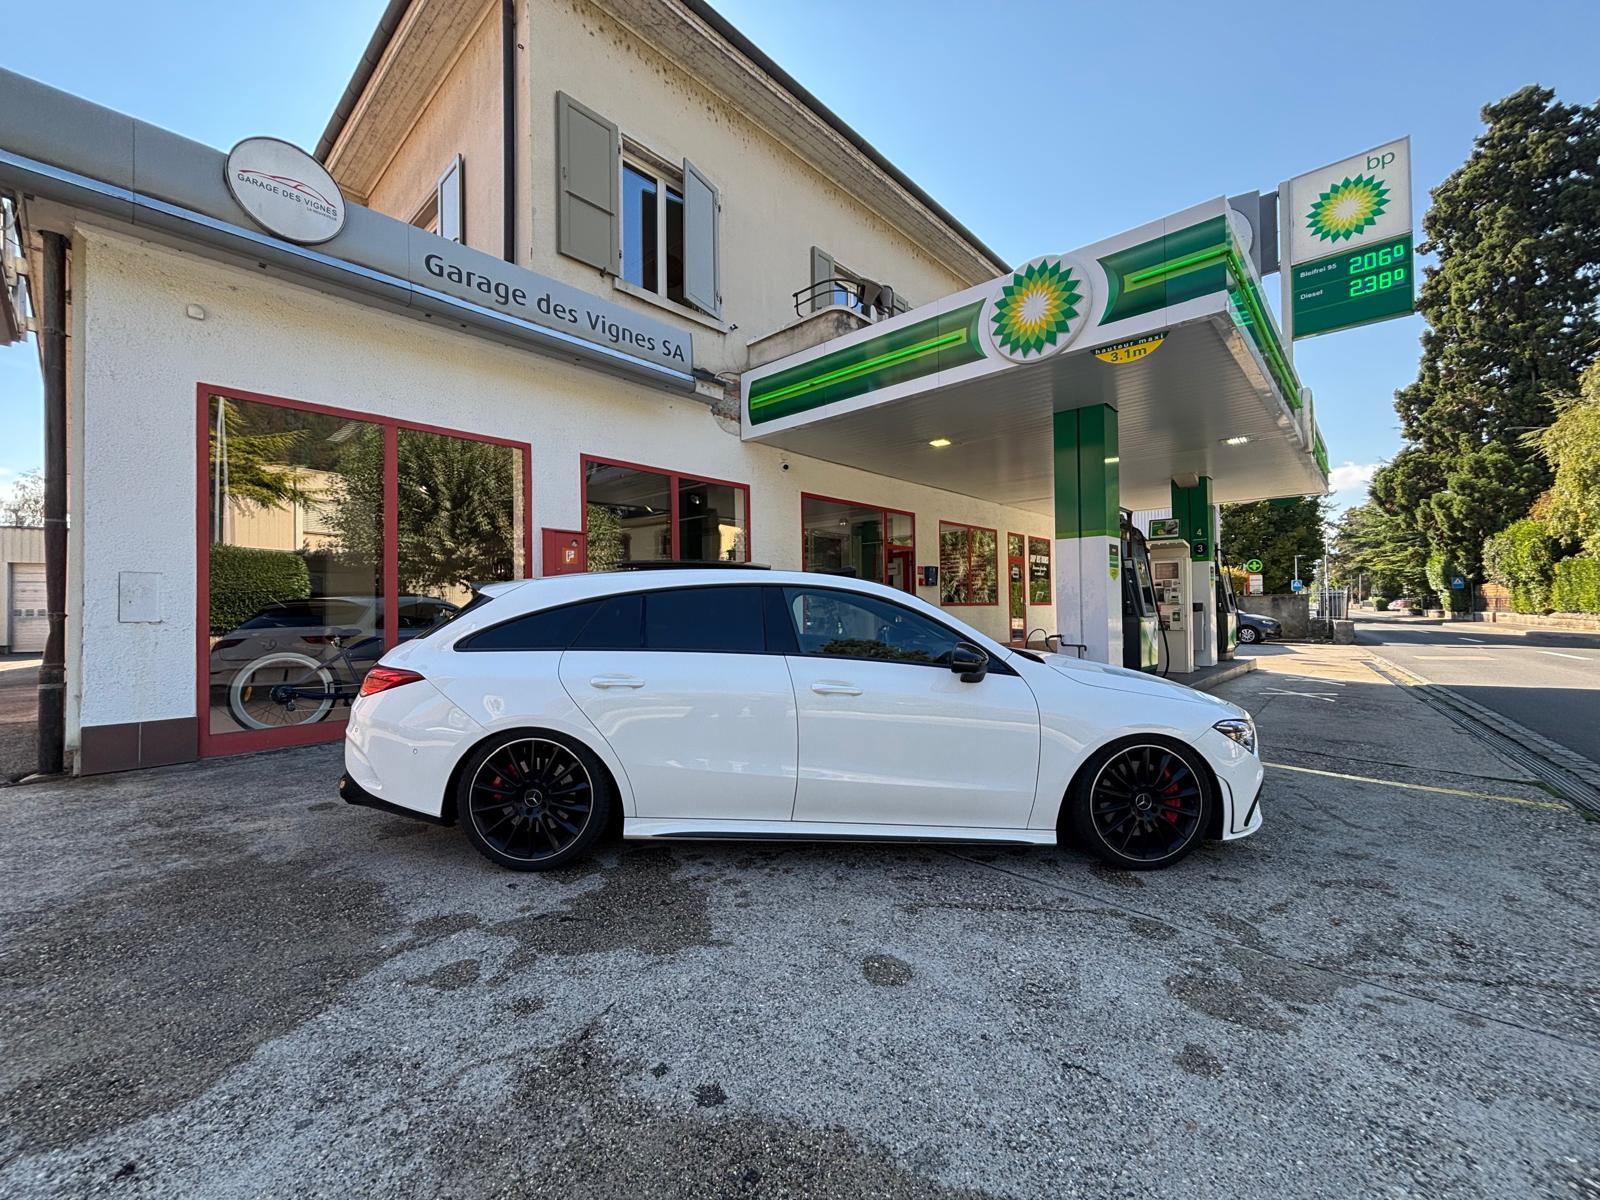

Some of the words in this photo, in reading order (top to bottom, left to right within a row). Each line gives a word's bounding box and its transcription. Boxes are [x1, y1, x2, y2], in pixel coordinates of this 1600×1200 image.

[1367, 152, 1395, 170] bp
[238, 173, 279, 194] GARAGE
[282, 190, 301, 203] DES
[304, 198, 338, 217] VIGNES
[1300, 267, 1326, 278] Bleifrei
[1327, 263, 1337, 272] 95
[1300, 289, 1323, 300] Diesel
[424, 253, 526, 306] Garage
[536, 294, 578, 323] des
[586, 310, 656, 352] Vignes
[662, 340, 685, 362] SA
[1095, 341, 1134, 355] hauteur
[1138, 333, 1164, 345] maxi
[1110, 347, 1147, 362] 3.1m
[1196, 528, 1202, 536] 4
[1197, 544, 1203, 553] 3
